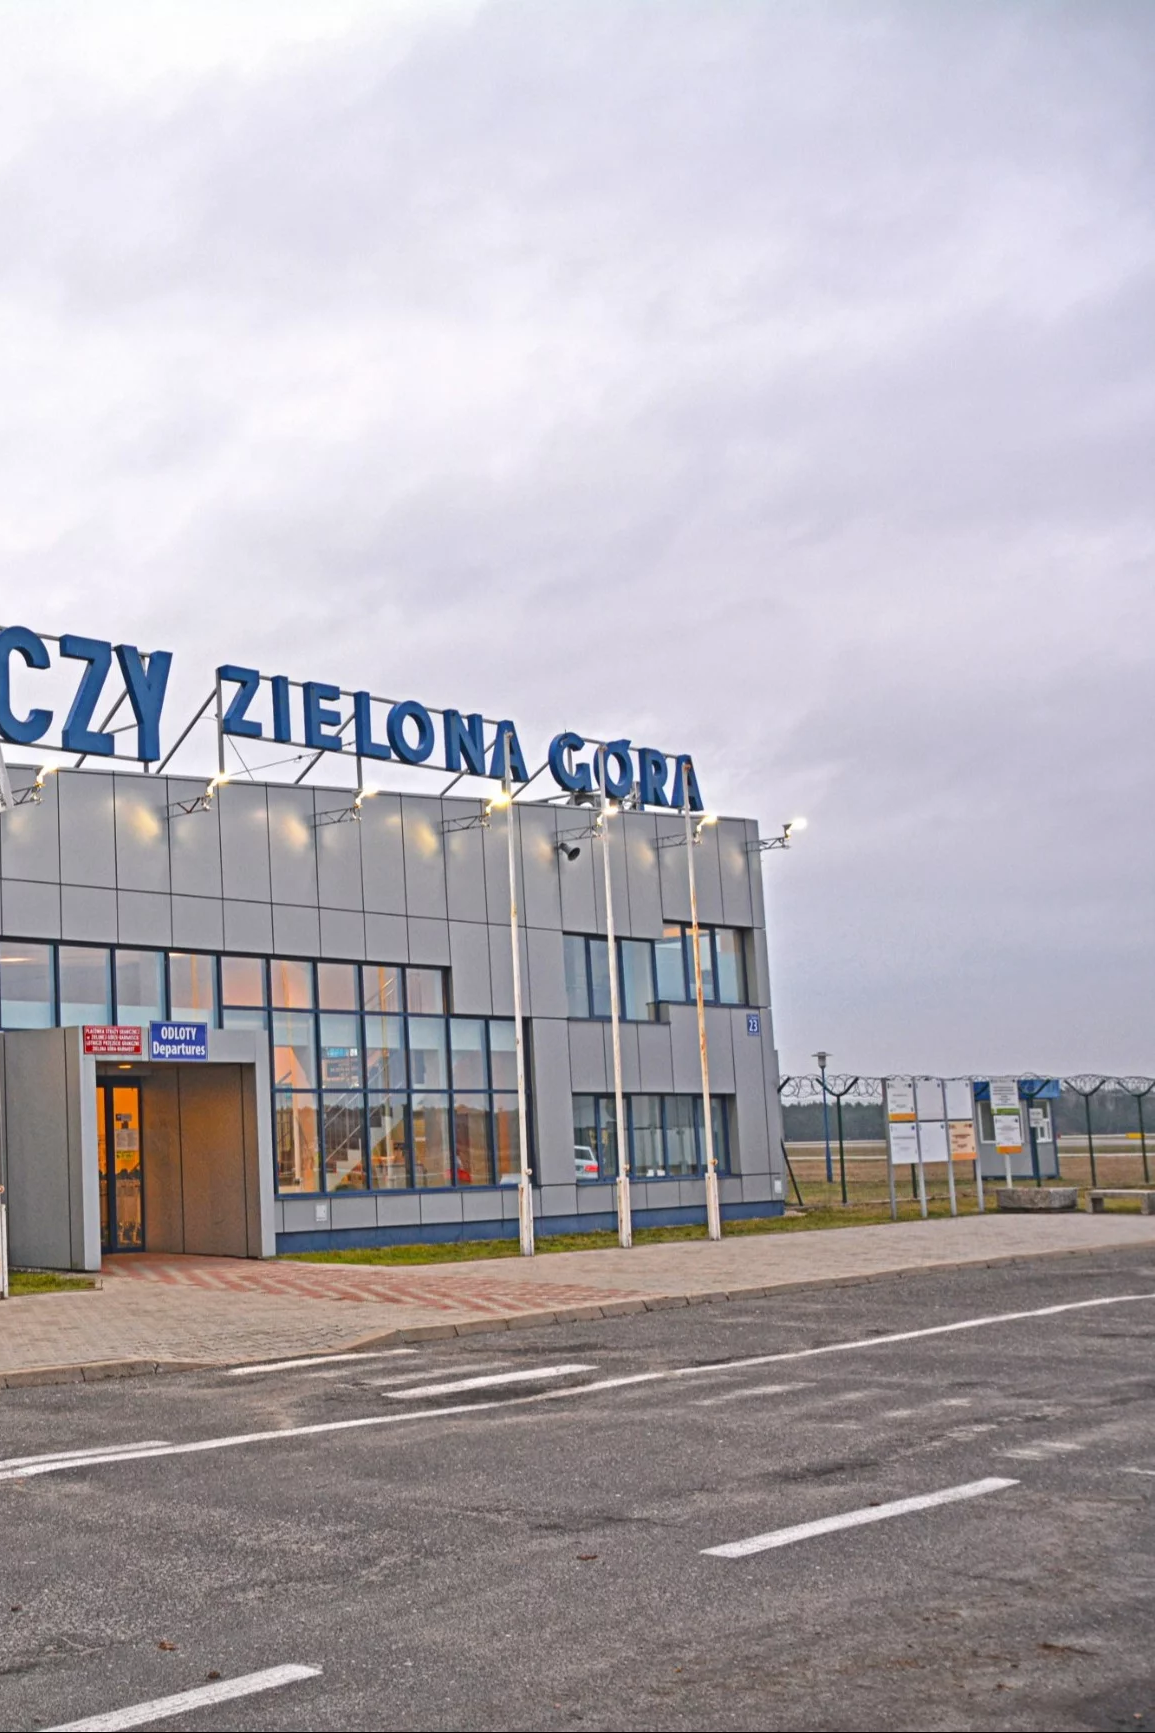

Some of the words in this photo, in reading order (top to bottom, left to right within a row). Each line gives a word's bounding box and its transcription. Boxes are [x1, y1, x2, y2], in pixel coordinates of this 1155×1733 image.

[217, 663, 530, 784] ZIELONA
[547, 730, 705, 812] GÓRA
[161, 1026, 197, 1041] ODLOTY
[748, 1019, 758, 1032] 23
[152, 1041, 206, 1058] Departures
